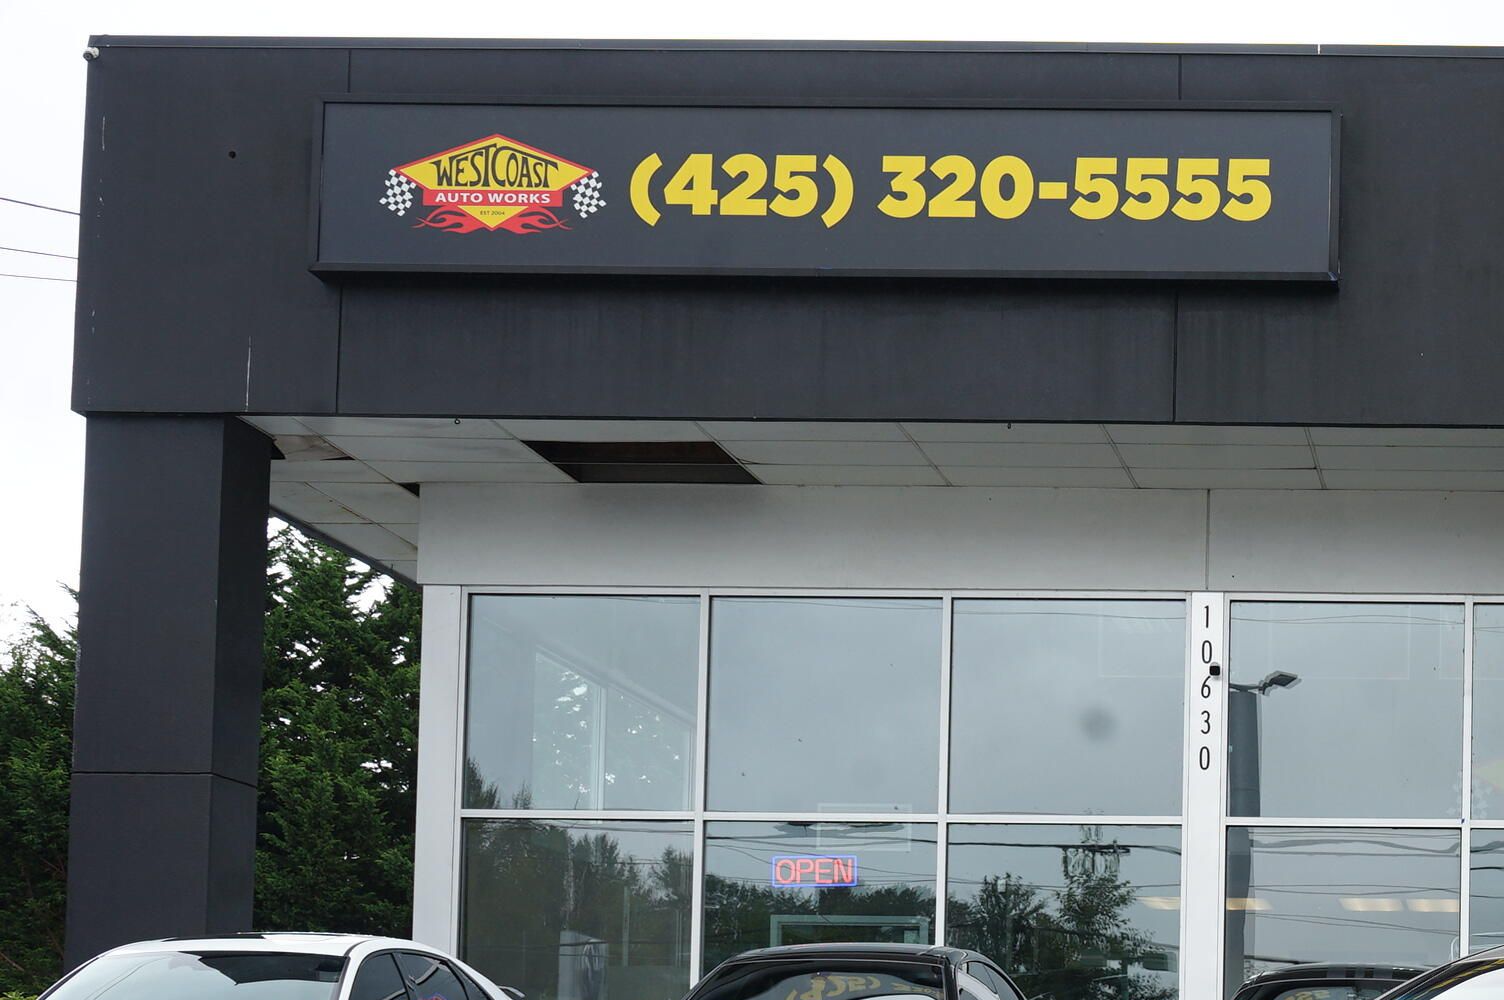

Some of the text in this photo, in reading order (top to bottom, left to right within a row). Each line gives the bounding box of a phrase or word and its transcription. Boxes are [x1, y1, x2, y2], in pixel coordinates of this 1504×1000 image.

[435, 192, 551, 204] AUTO WORKS
[630, 152, 1272, 229] (425) 320-5555
[1199, 605, 1213, 770] 10630
[775, 858, 852, 884] OPEN
